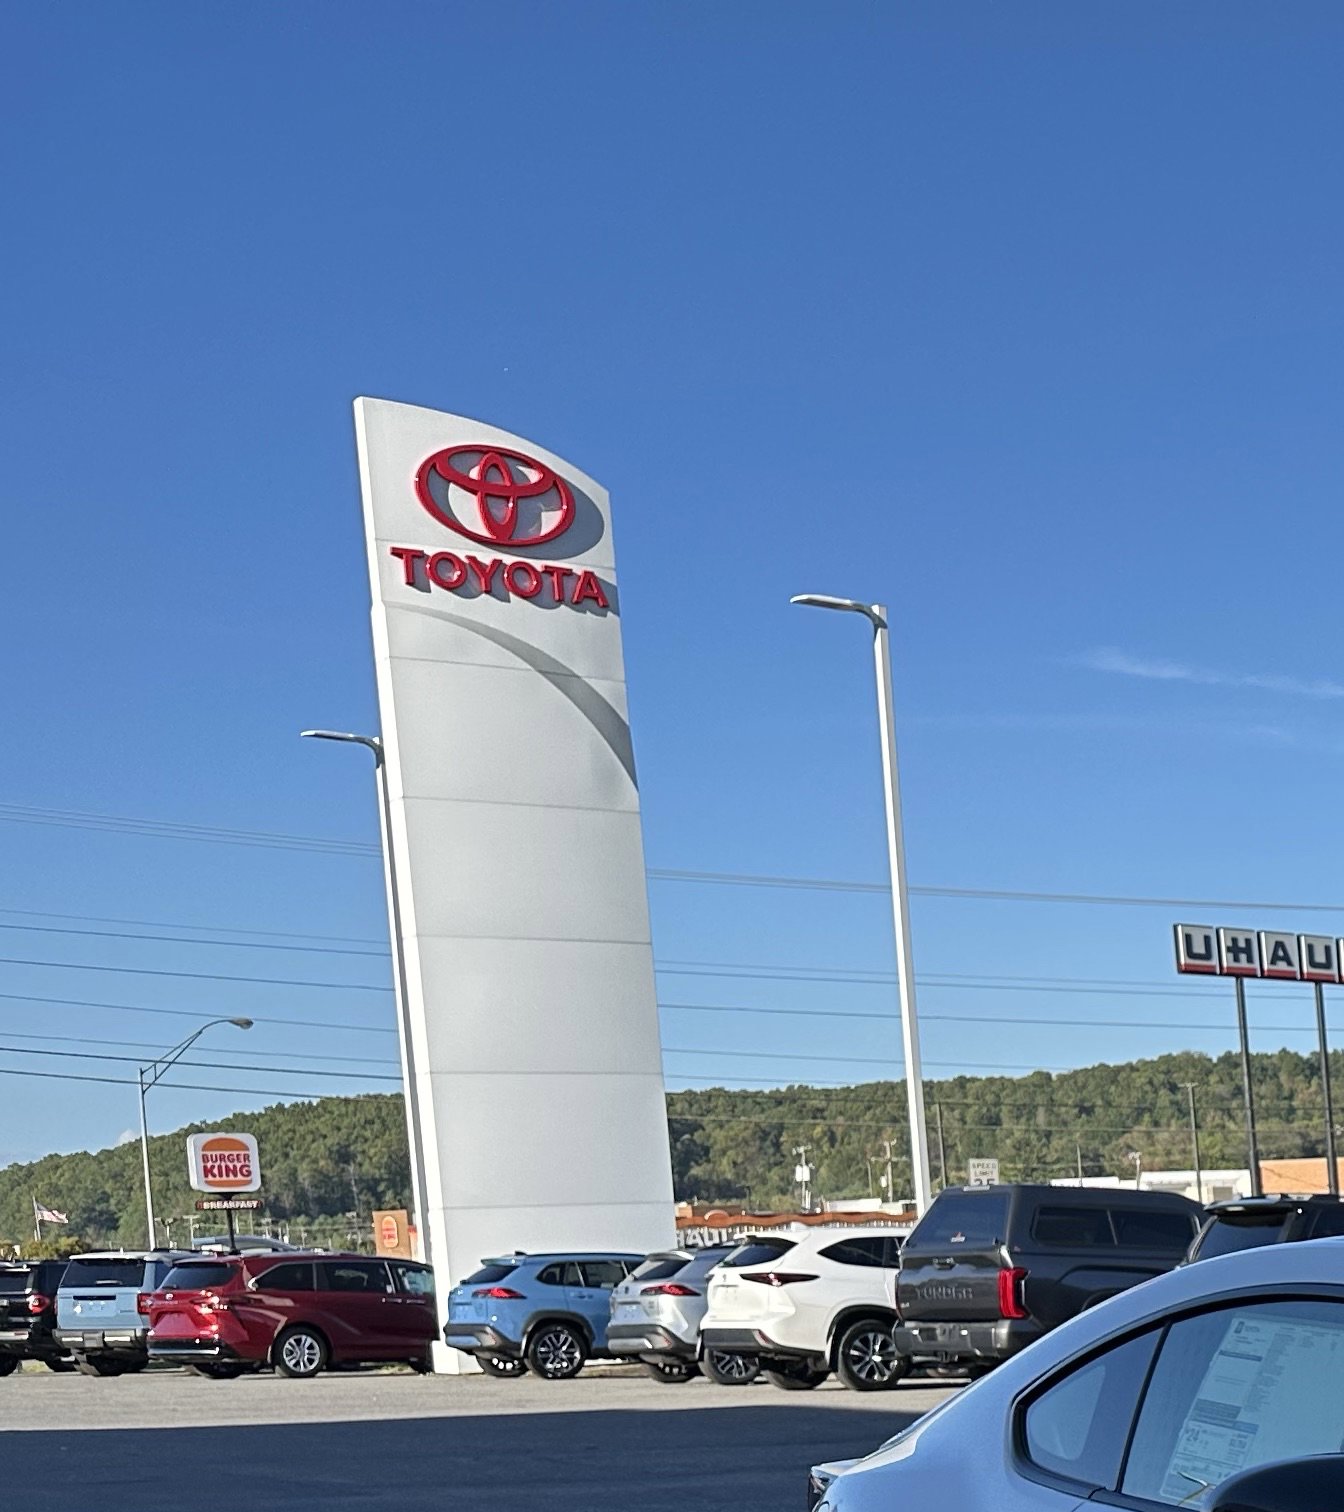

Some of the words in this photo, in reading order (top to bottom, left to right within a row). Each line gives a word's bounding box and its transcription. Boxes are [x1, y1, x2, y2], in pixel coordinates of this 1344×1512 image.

[390, 546, 609, 608] TOYOTA
[202, 1153, 250, 1164] BURGER
[202, 1164, 252, 1178] KING
[203, 1200, 258, 1210] BREAKFAST
